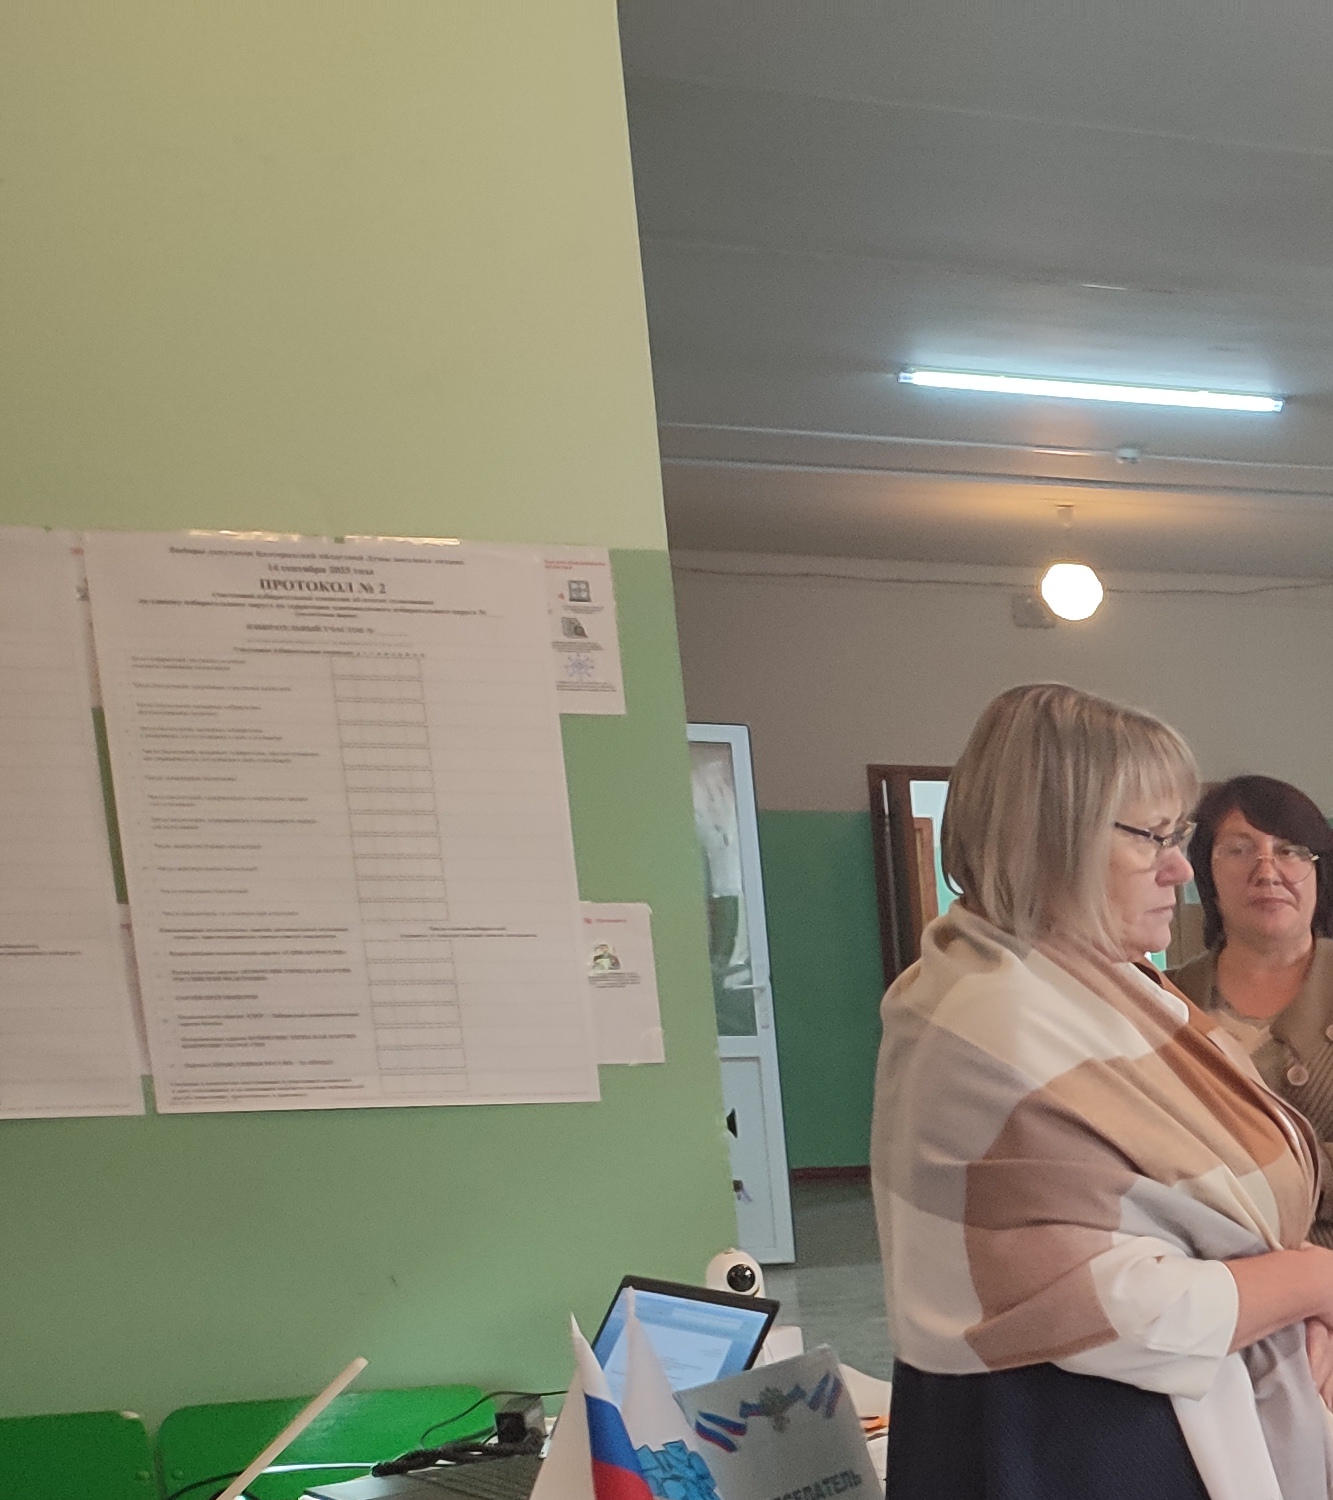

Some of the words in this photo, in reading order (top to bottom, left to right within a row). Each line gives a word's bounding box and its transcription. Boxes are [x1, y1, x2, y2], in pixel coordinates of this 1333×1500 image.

[260, 578, 353, 593] ПРОТОКОЛ
[358, 582, 374, 593] №
[379, 583, 386, 594] 2
